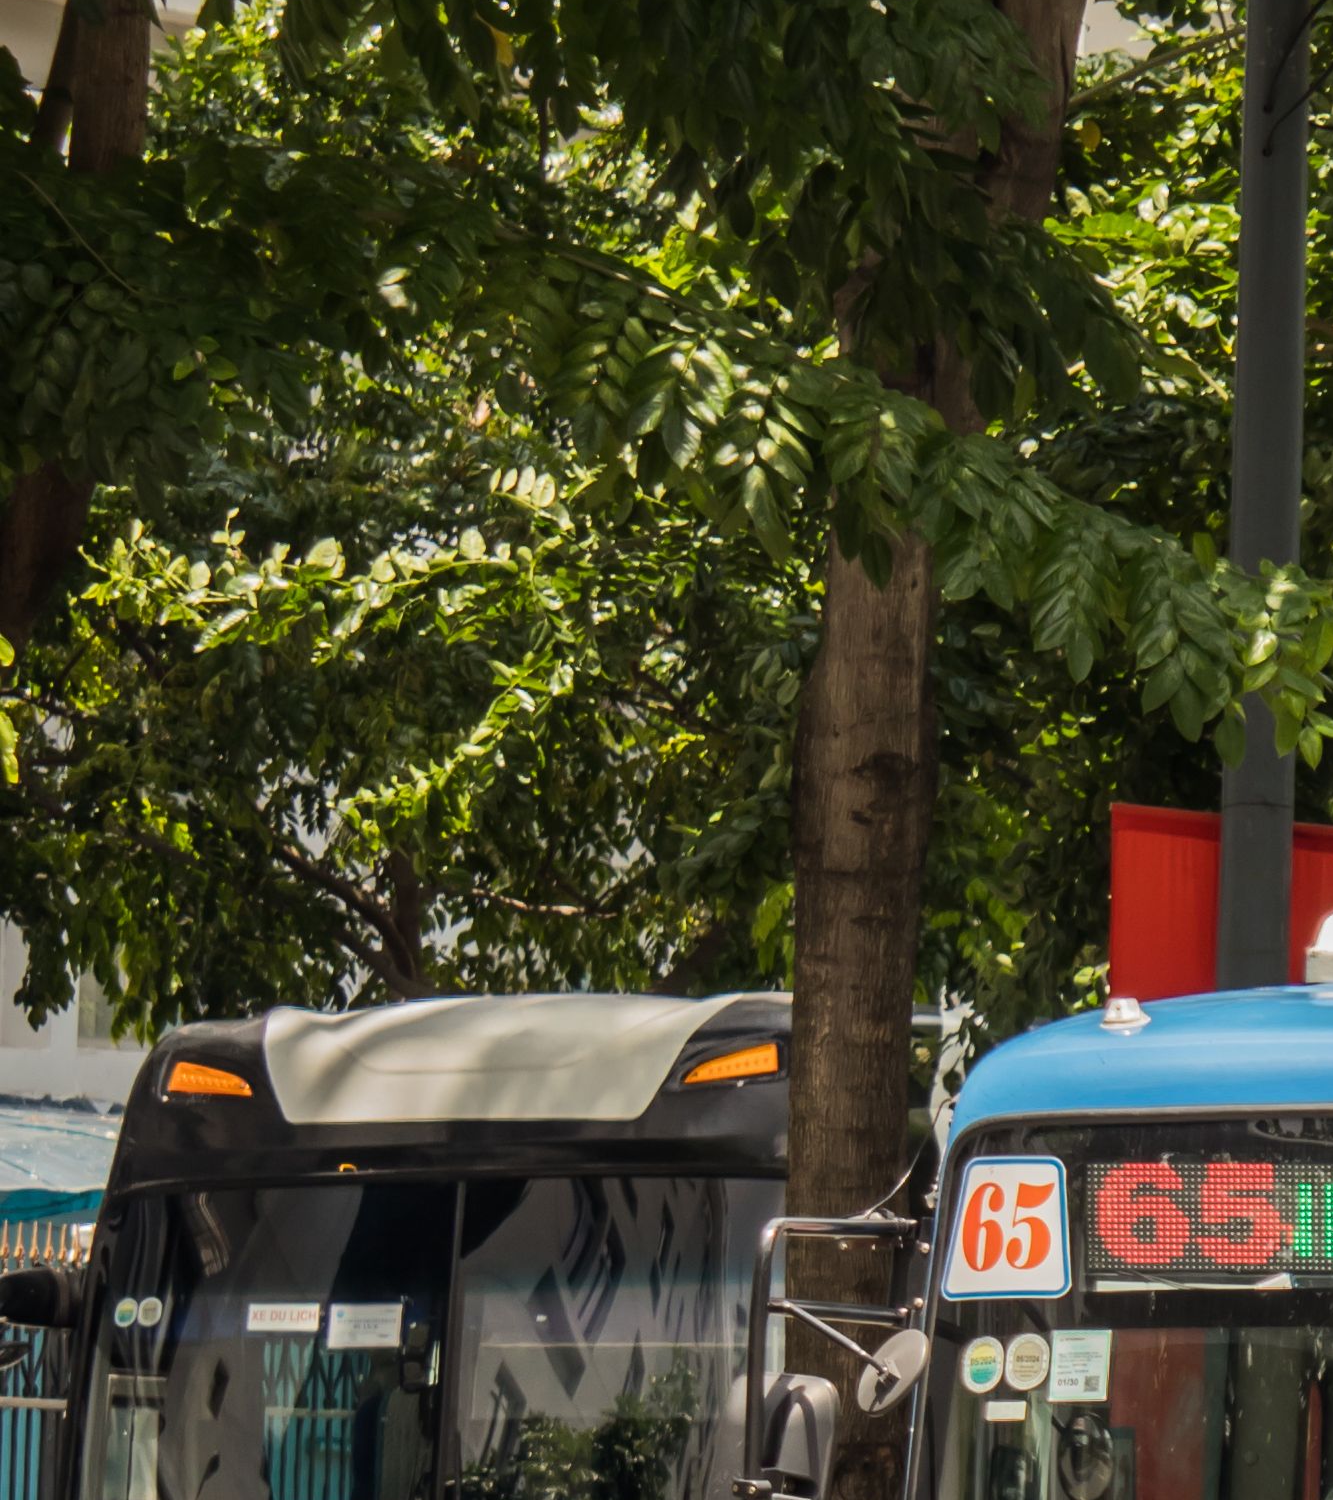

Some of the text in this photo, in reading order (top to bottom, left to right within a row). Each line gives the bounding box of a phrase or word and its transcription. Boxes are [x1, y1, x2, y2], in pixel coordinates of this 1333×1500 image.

[962, 1182, 1055, 1272] 65
[1097, 1162, 1282, 1265] 65
[251, 1310, 267, 1322] XE
[270, 1310, 287, 1322] DU
